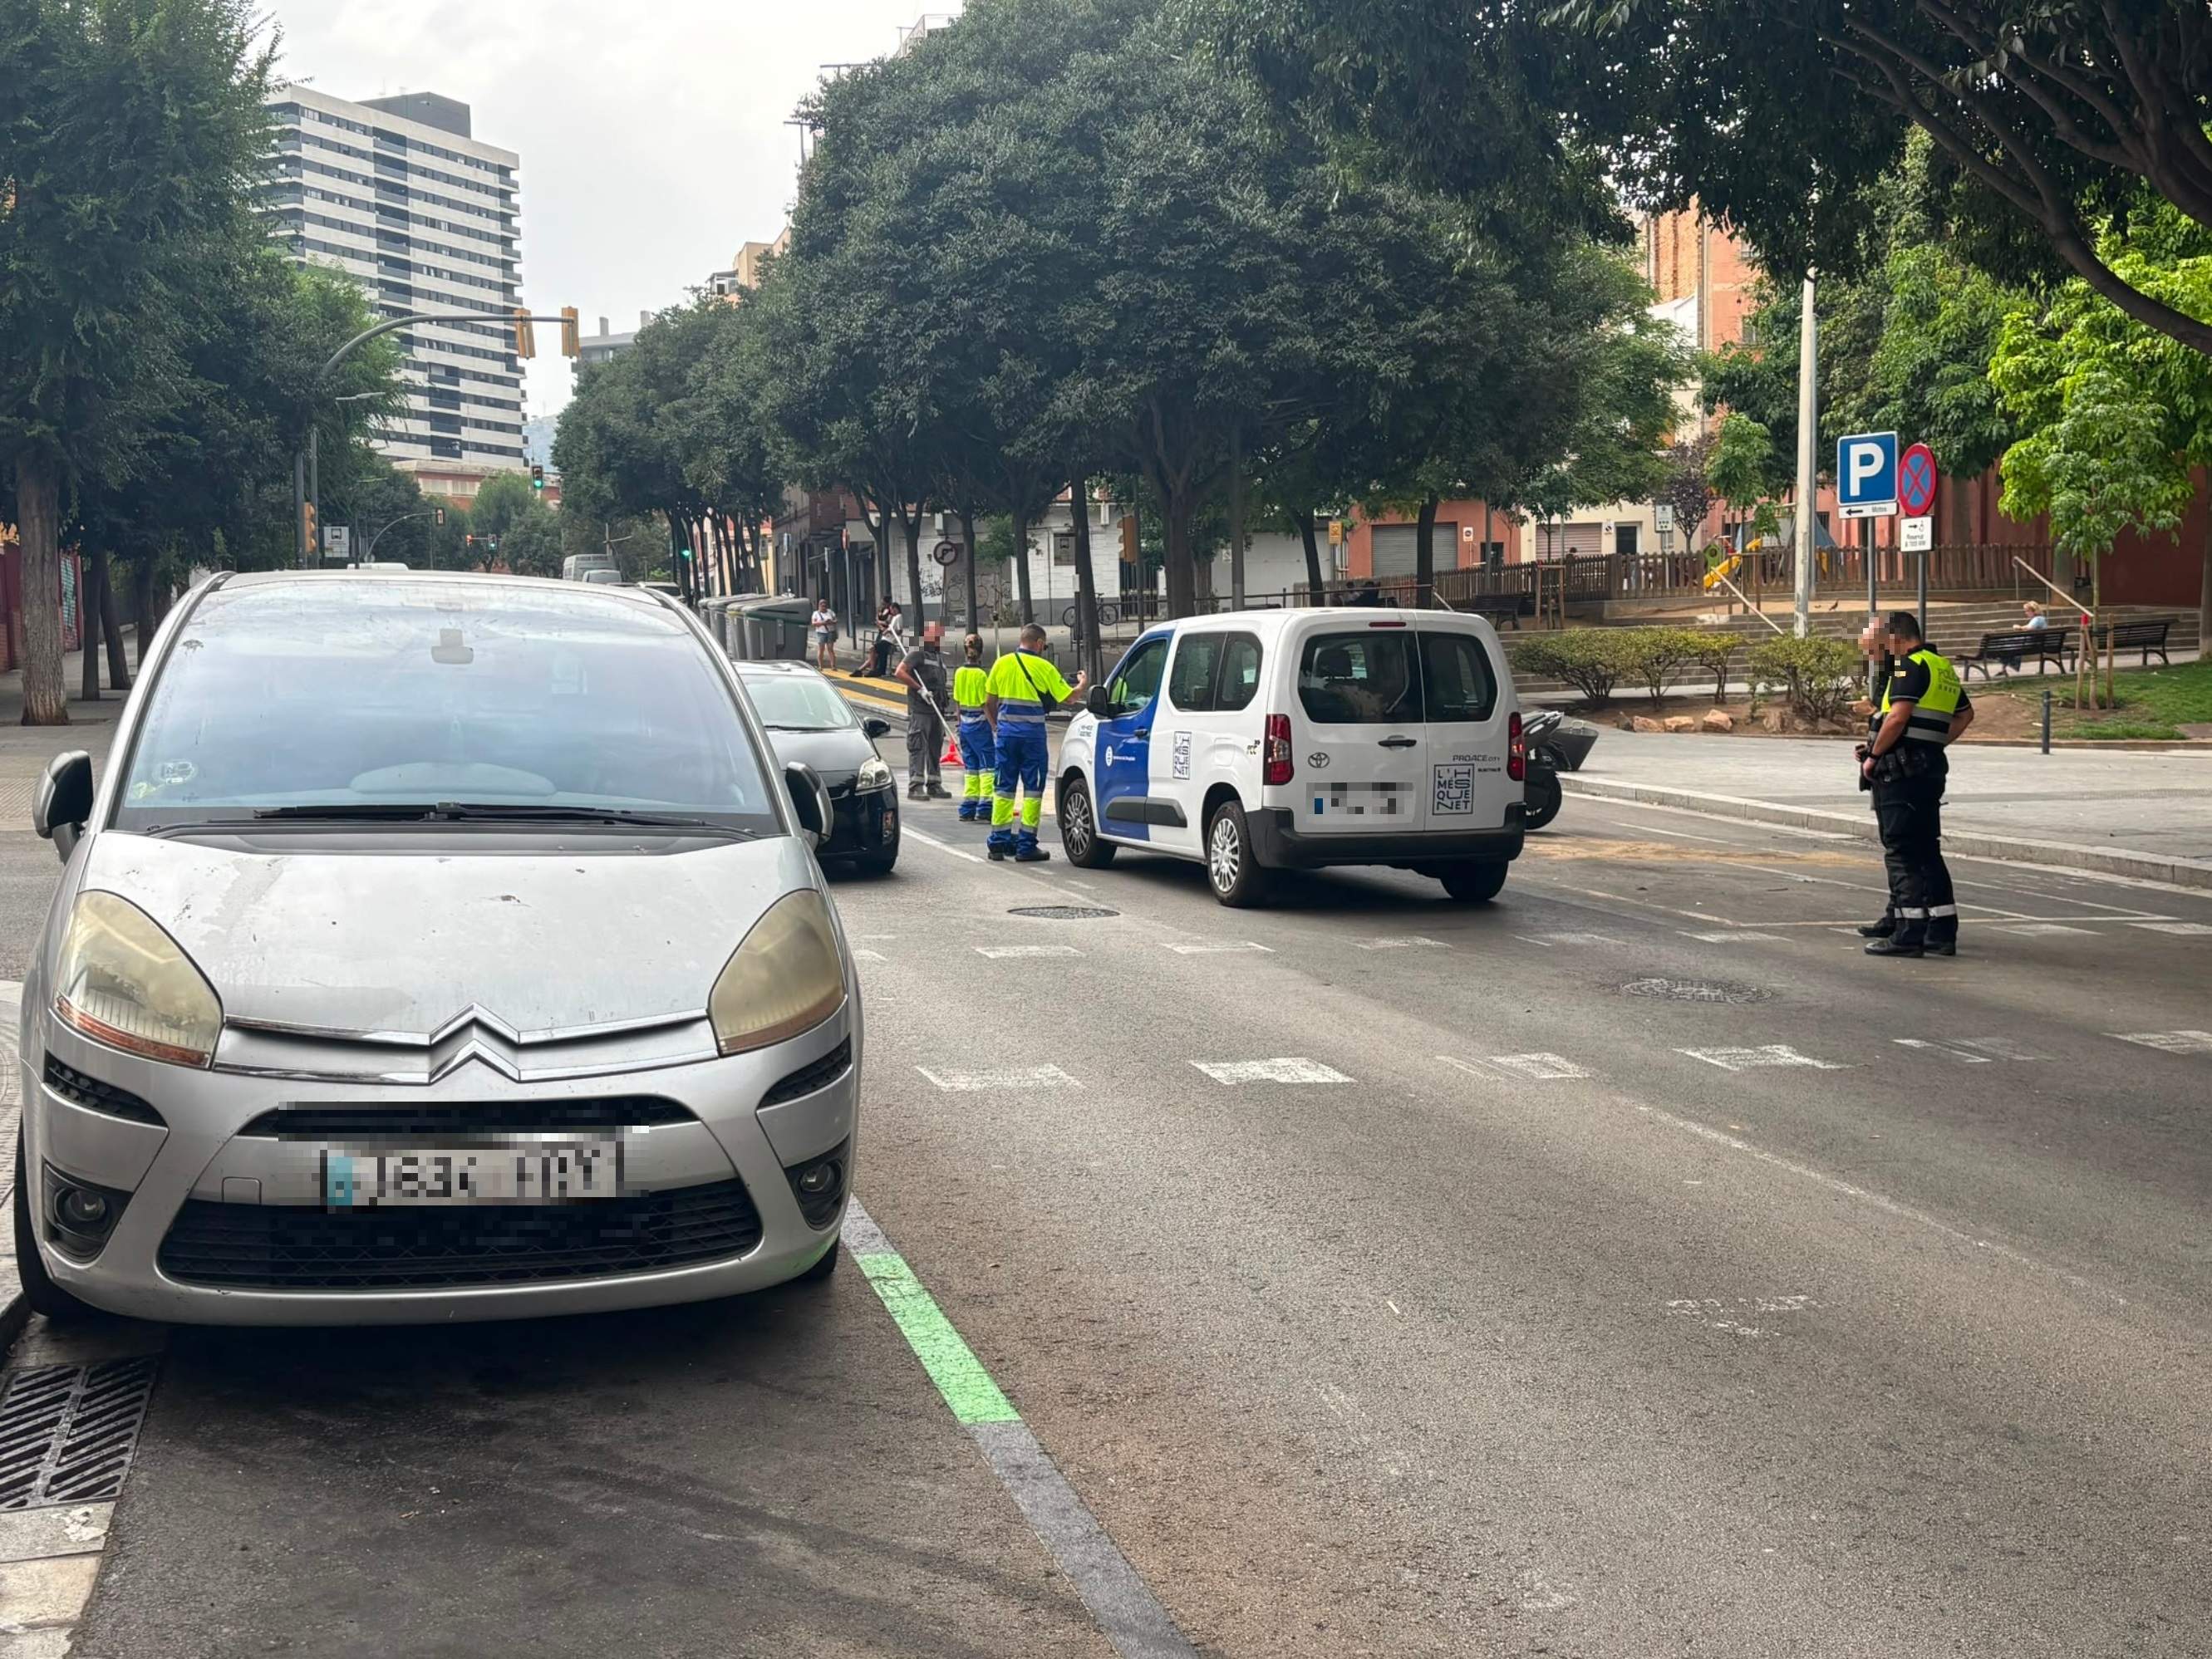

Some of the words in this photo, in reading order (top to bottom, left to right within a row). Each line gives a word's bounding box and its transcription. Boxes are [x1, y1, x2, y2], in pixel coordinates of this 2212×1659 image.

[1850, 443, 1885, 497] P
[1453, 754, 1487, 763] PROACE
[1437, 778, 1471, 789] MÉS
[1437, 790, 1471, 801] QUE
[1436, 800, 1471, 811] NET
